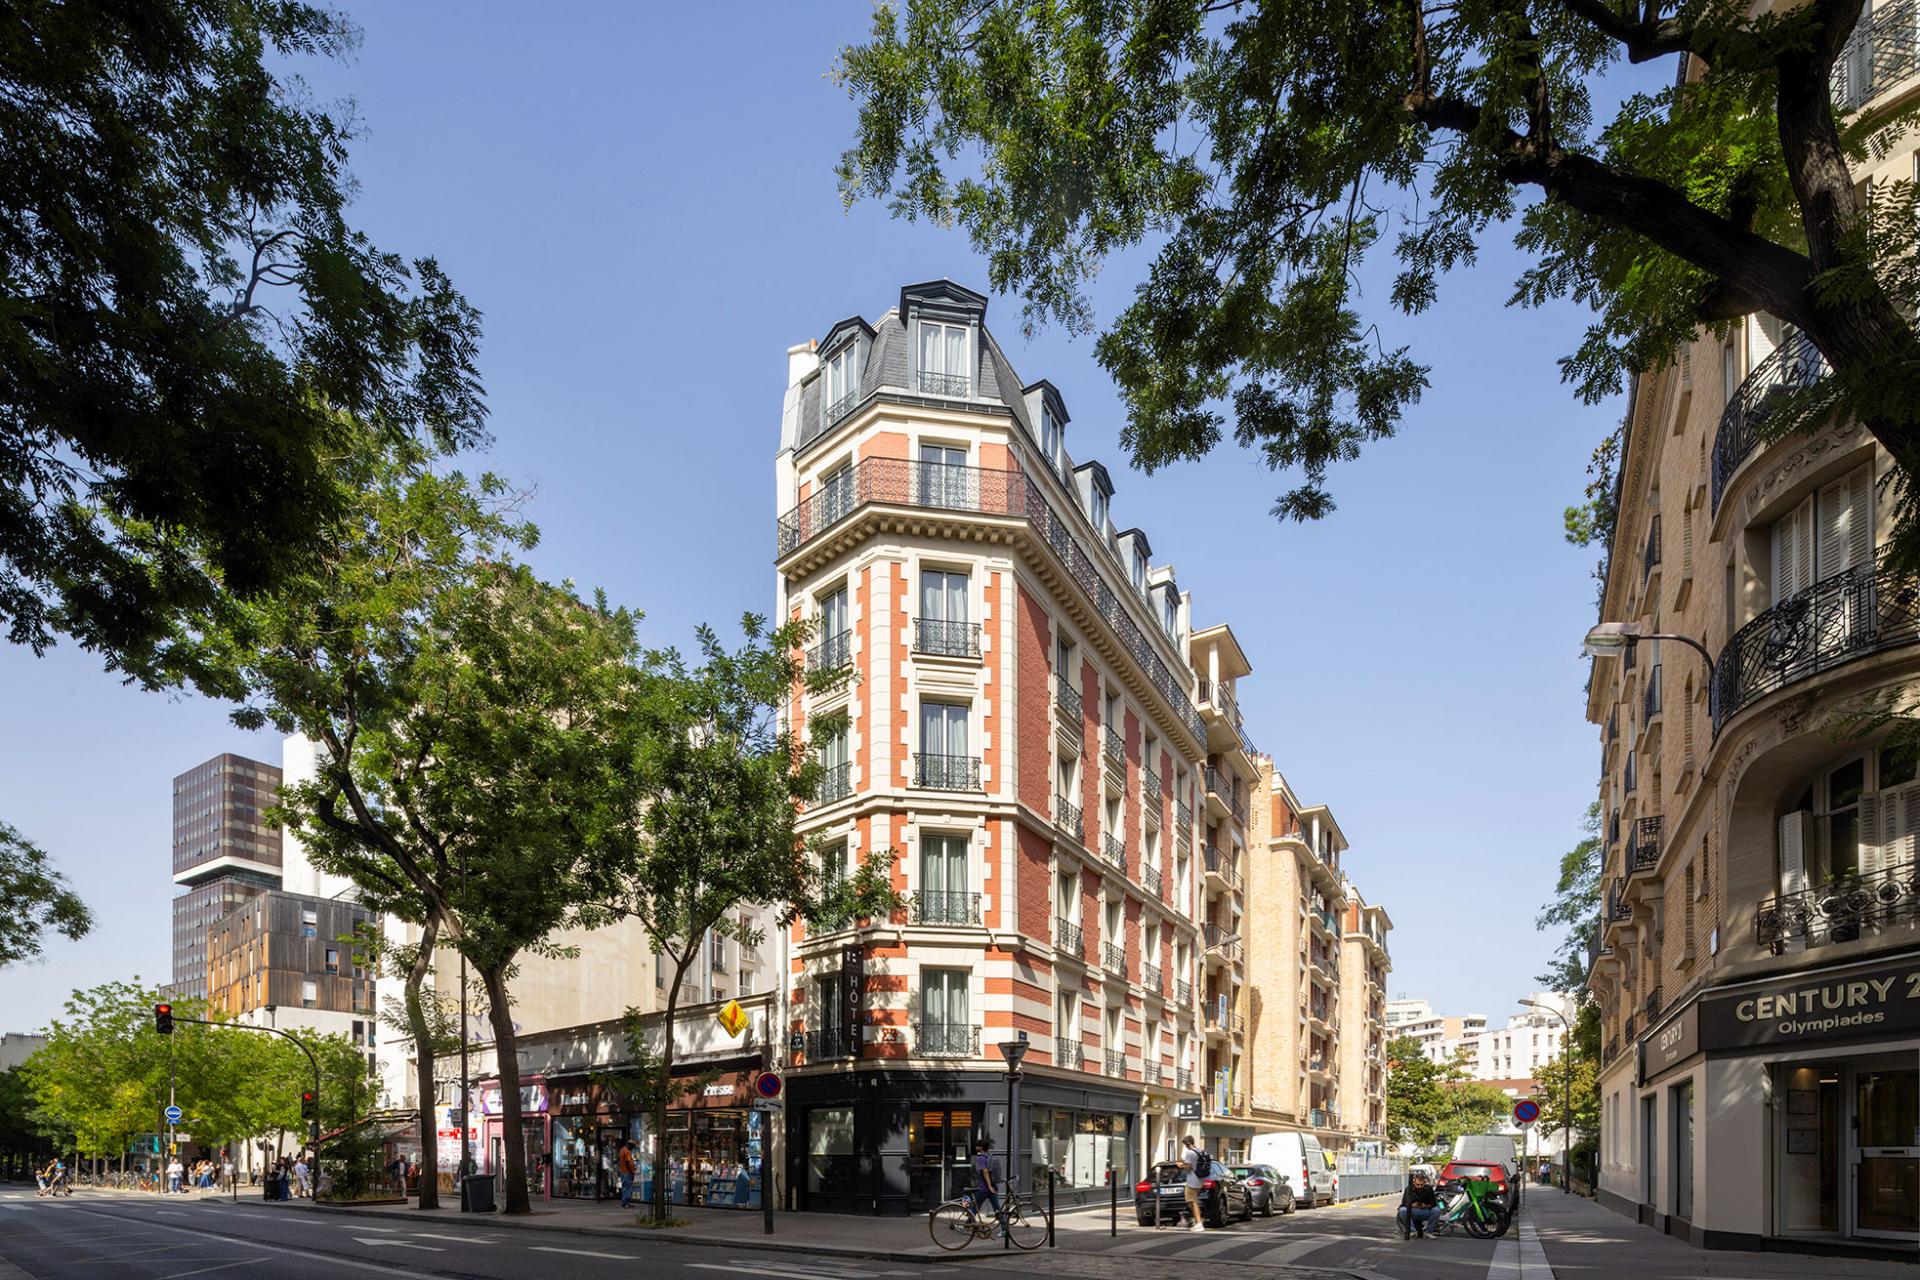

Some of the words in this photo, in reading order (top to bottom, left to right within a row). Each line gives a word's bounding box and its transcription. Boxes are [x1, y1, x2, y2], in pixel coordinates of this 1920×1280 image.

[849, 975, 859, 1053] HÔTEL
[1736, 976, 1896, 1022] CENTURY
[1778, 1011, 1885, 1035] Olympiades
[703, 1084, 734, 1096] Presse
